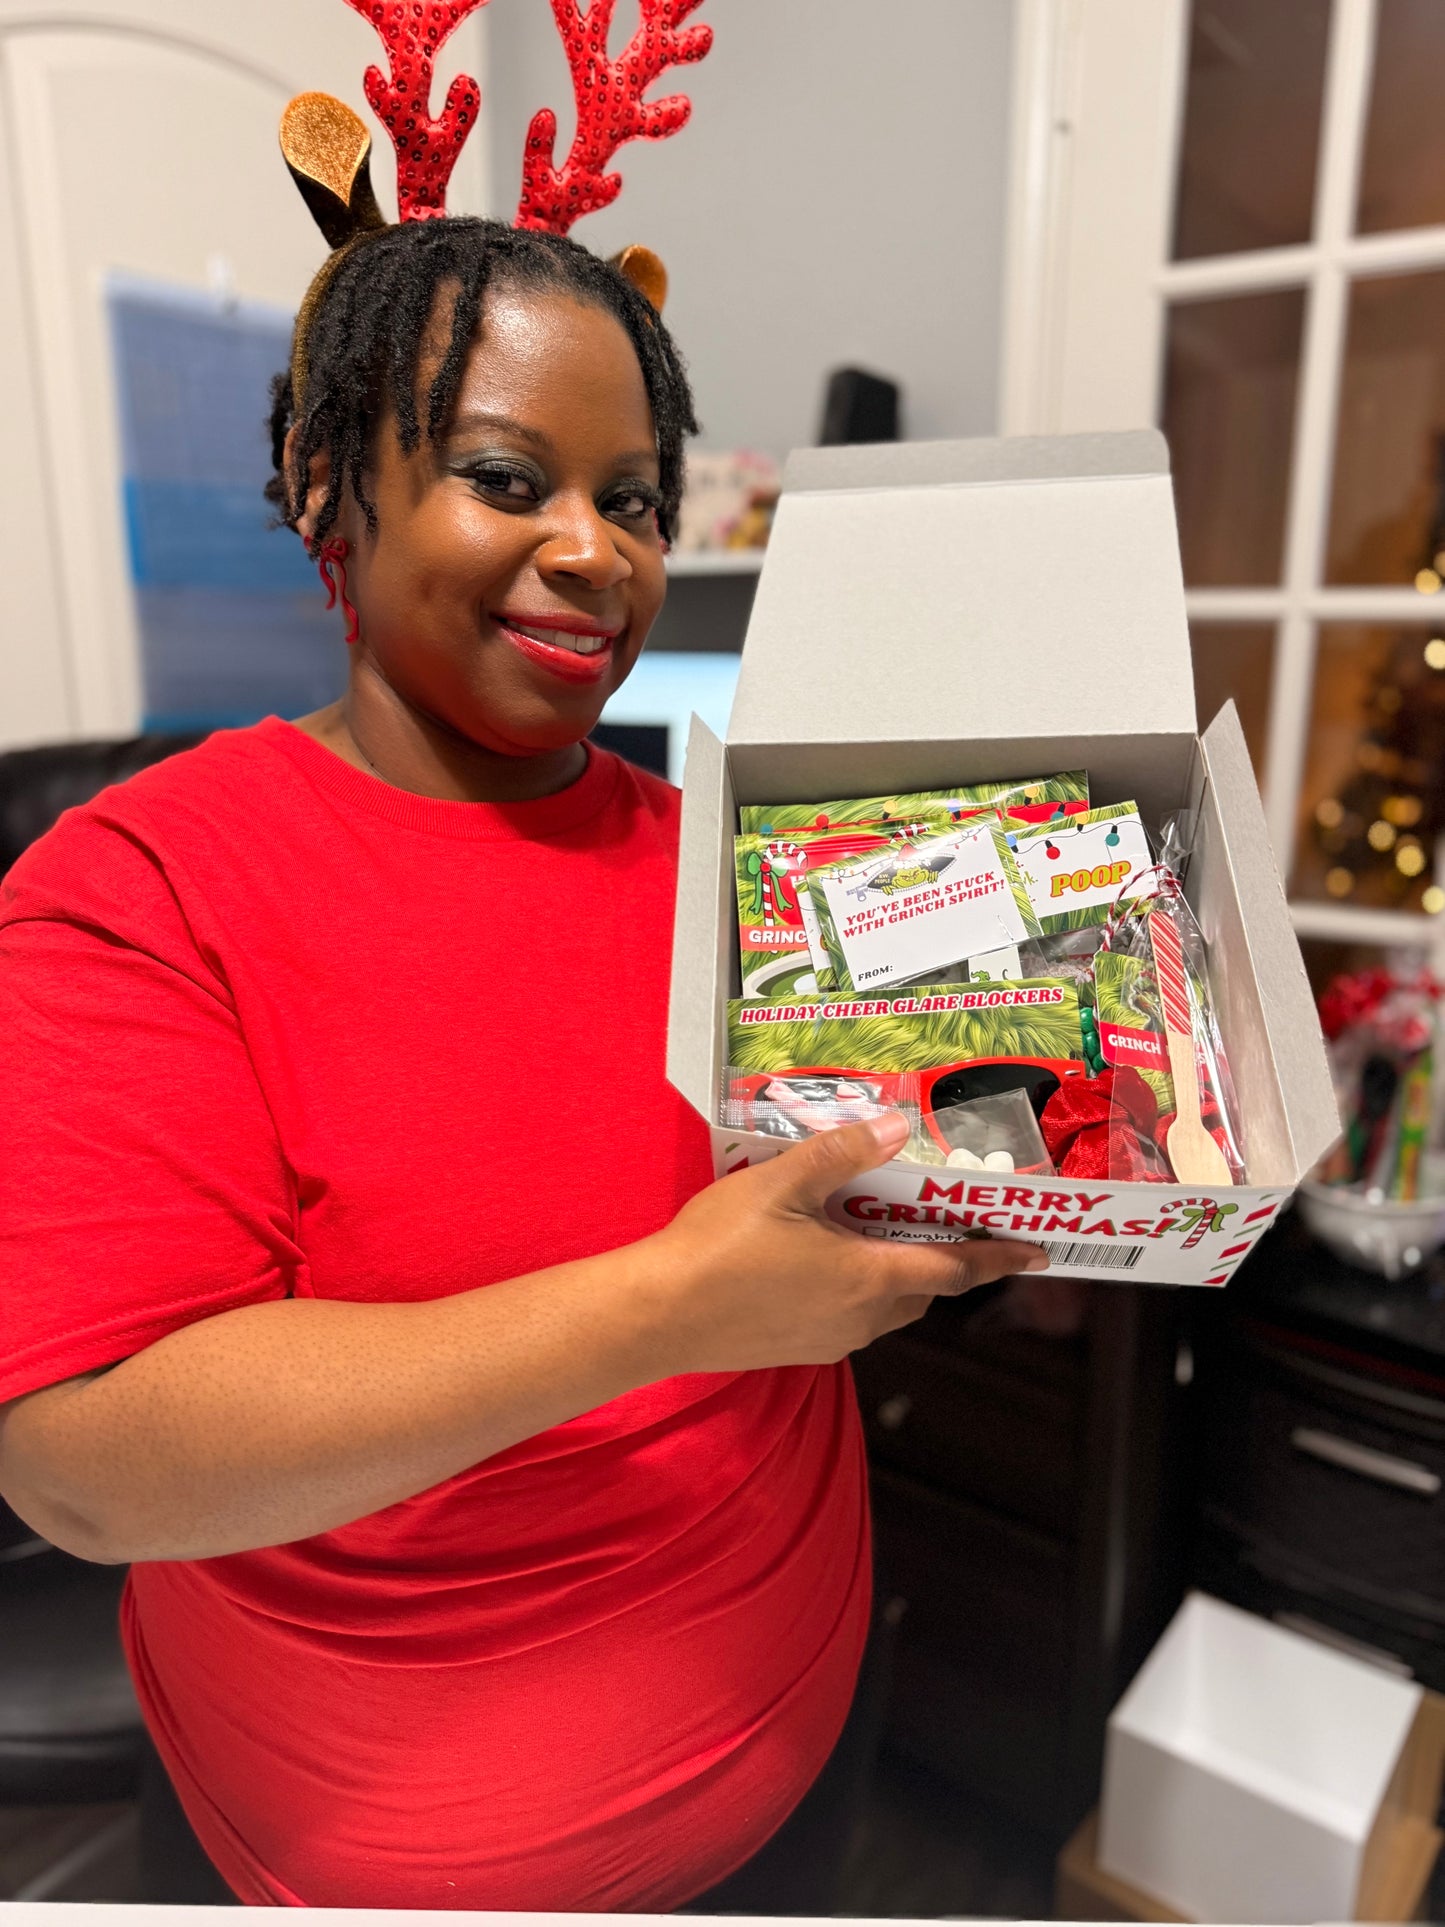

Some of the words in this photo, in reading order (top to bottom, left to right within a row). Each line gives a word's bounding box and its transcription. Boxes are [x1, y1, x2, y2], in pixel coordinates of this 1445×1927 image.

[1050, 860, 1132, 897] POOP
[843, 918, 885, 938] WITH
[888, 899, 945, 924] GRINCH
[949, 879, 1005, 905] SPIRIT!
[846, 901, 900, 926] YOU'VE
[903, 887, 941, 908] BEEN
[944, 871, 995, 894] STUCK
[858, 965, 894, 981] FROM:
[739, 1003, 821, 1024] HOLIDAY
[822, 1000, 890, 1019] CHEER
[892, 995, 959, 1014] GLARE
[961, 987, 1064, 1010] BLOCKERS
[1107, 1034, 1162, 1056] GRINCH
[916, 1175, 1115, 1212] MERRY
[843, 1195, 1180, 1238] GRINCHMAS!
[889, 1229, 964, 1243] Naughty
